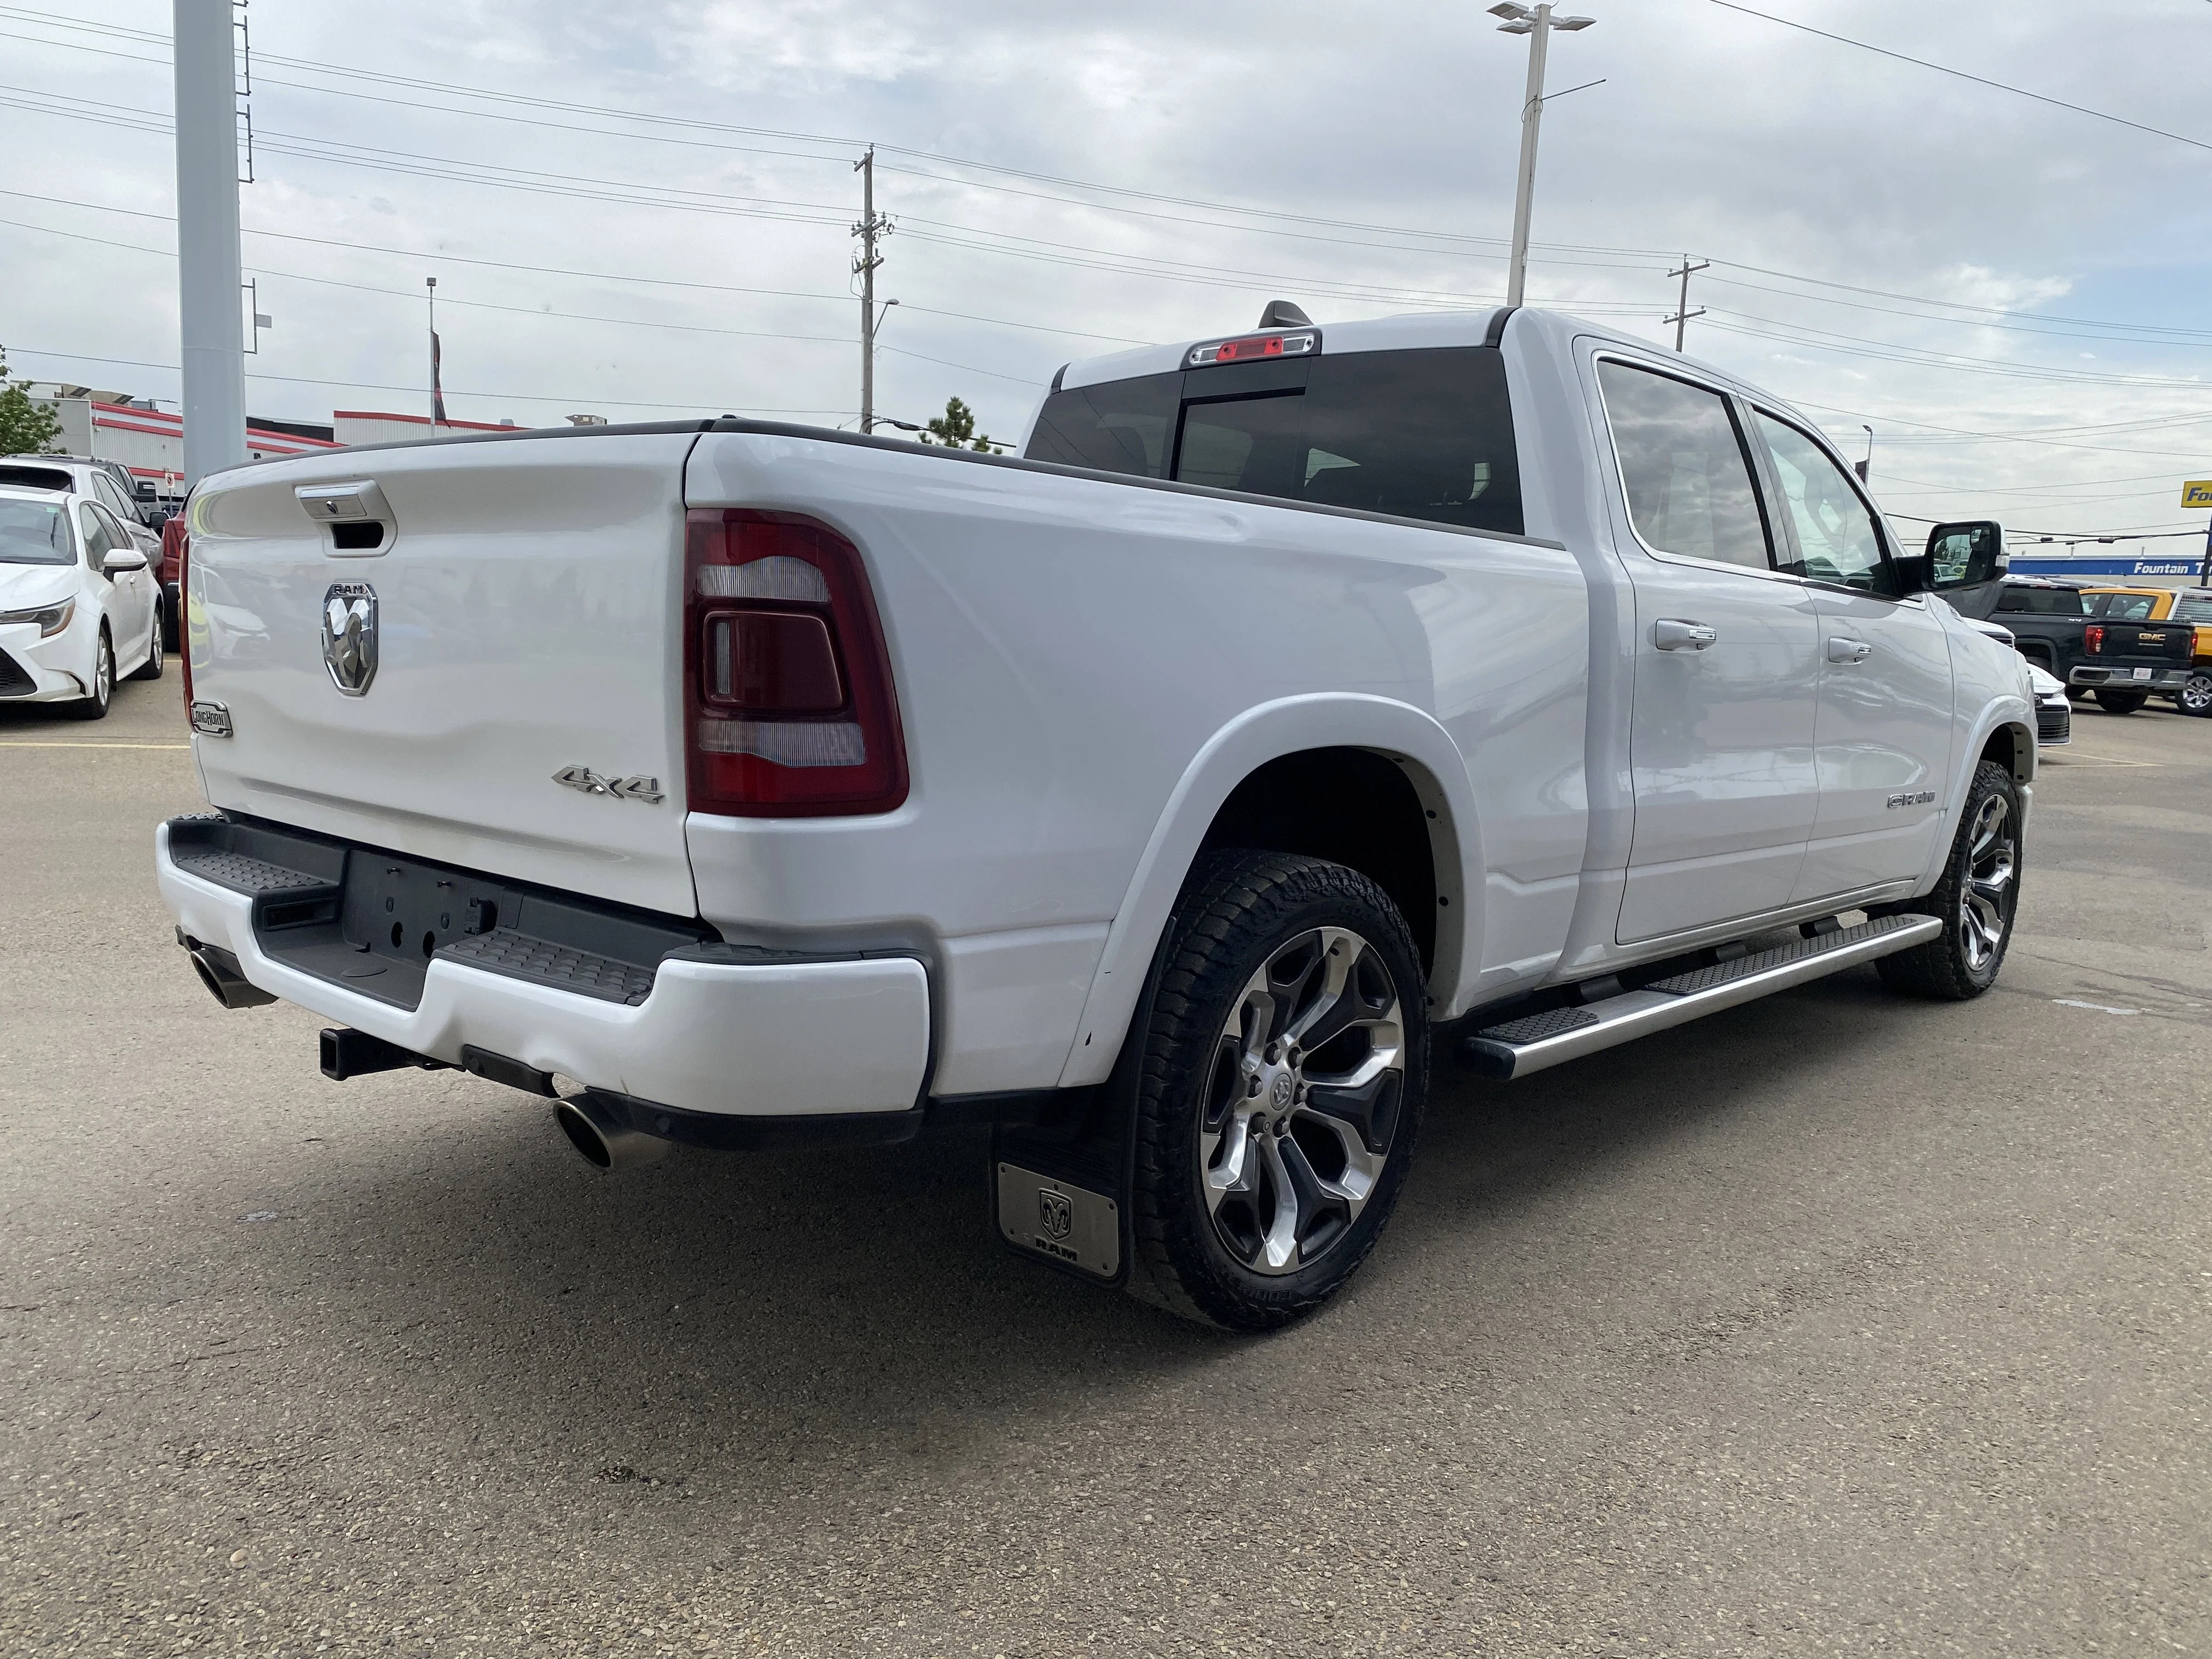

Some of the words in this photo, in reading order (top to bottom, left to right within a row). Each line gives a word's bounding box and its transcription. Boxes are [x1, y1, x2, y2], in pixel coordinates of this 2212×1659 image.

[2134, 562, 2189, 574] Fountain
[332, 585, 363, 595] RAM
[2139, 633, 2166, 641] GMC
[1902, 790, 1936, 805] RAM
[1035, 1237, 1077, 1262] RAM
